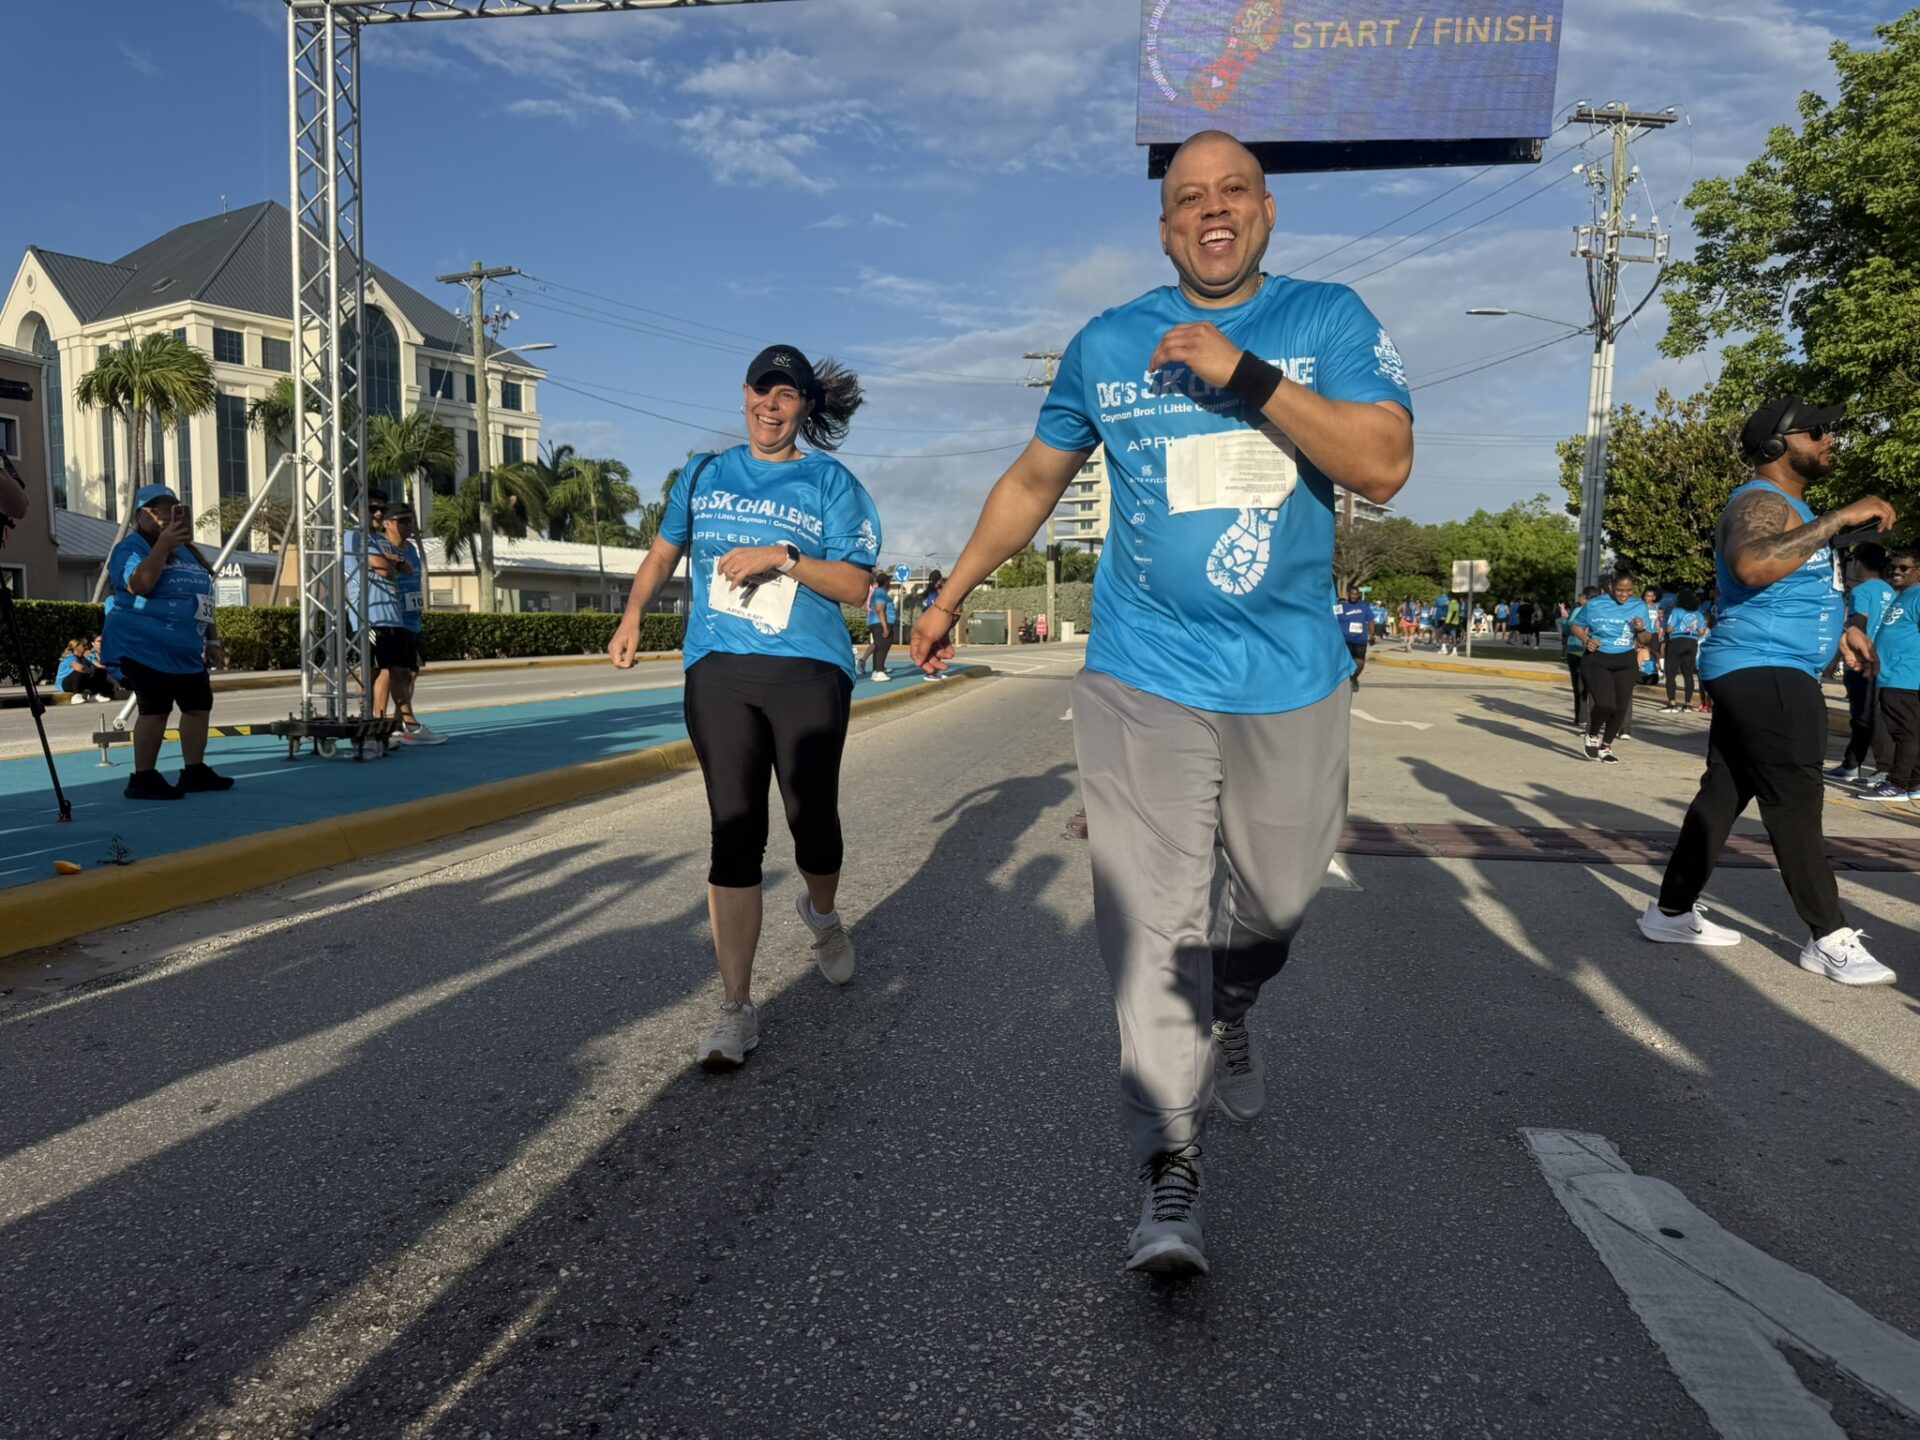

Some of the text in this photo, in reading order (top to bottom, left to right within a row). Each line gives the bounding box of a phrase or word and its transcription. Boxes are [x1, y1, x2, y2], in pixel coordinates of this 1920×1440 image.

[1147, 33, 1158, 51] THE
[1292, 18, 1400, 49] START
[1407, 16, 1424, 50] /
[1433, 14, 1555, 46] FINISH
[1096, 381, 1138, 409] DG'S
[1100, 410, 1132, 423] Cayman
[1133, 406, 1156, 417] Brac
[1163, 403, 1193, 414] Little
[708, 490, 739, 511] 5K
[736, 499, 823, 536] CHALLENGE
[717, 512, 736, 521] Little
